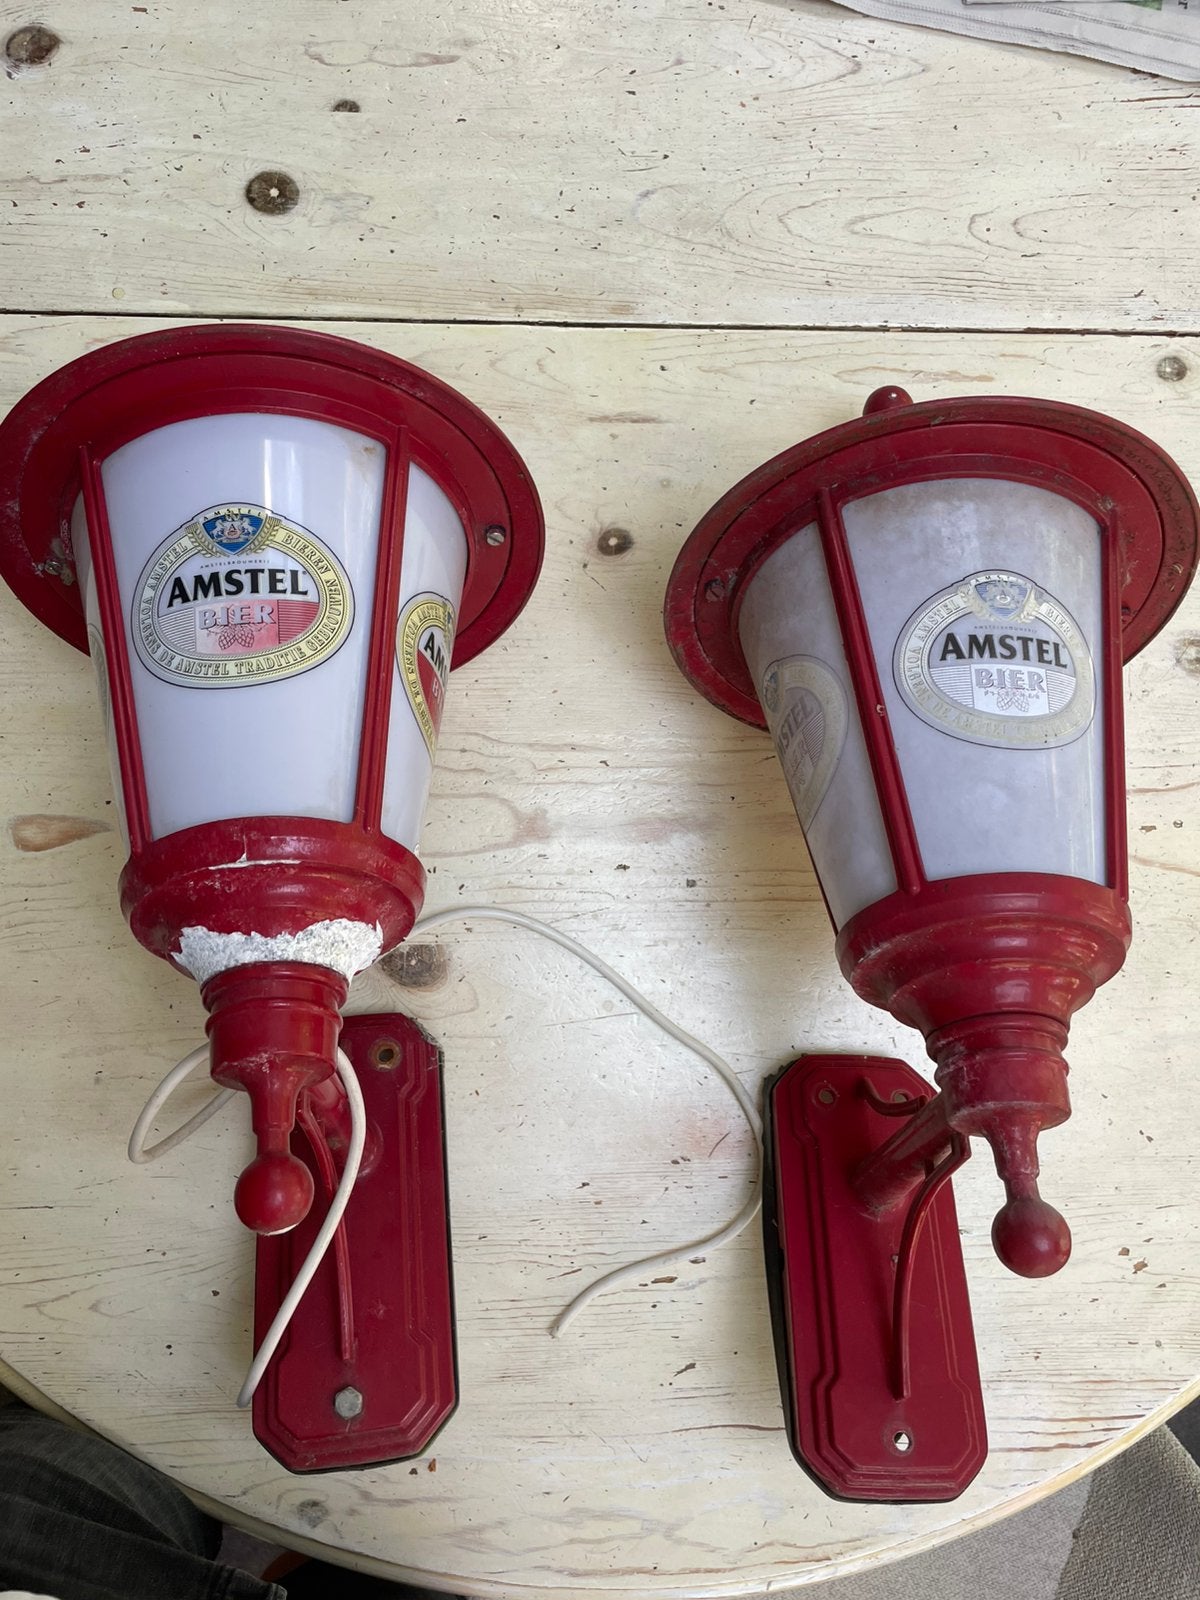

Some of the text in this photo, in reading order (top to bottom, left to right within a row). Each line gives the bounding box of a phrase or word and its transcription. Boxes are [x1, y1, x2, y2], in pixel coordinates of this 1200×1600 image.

[147, 532, 332, 592] AMSTEL BIEREN
[166, 568, 309, 609] AMSTEL
[199, 604, 277, 630] BIER
[174, 658, 230, 676] AMSTEL
[234, 645, 307, 675] TRADITIE
[939, 632, 1068, 669] AMSTEL
[974, 668, 1047, 693] BIER
